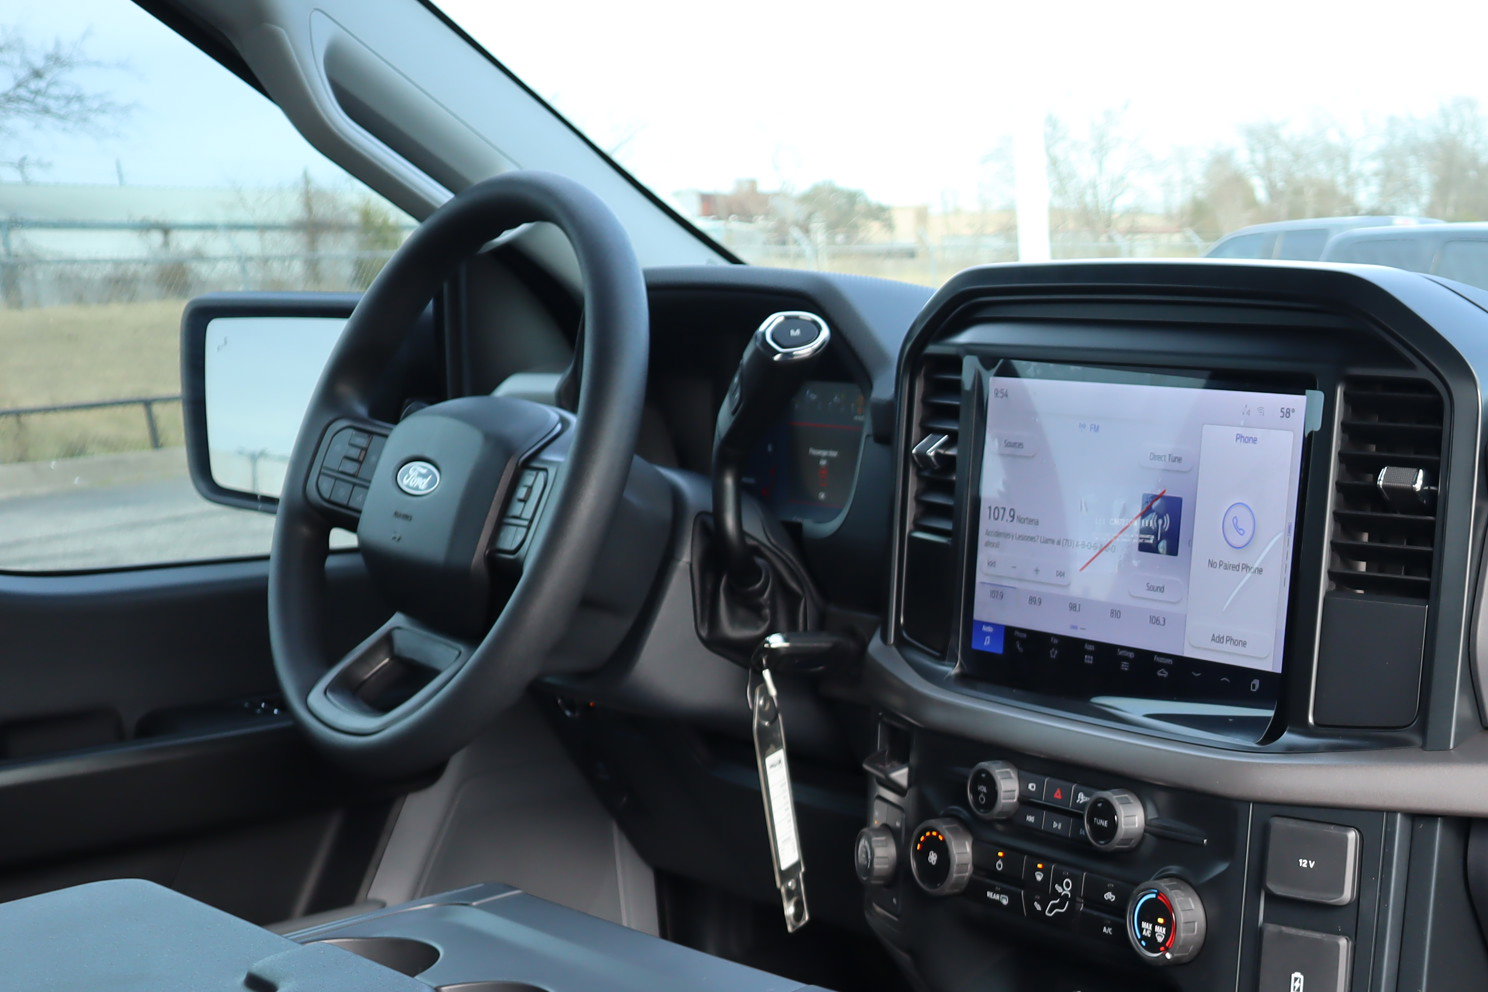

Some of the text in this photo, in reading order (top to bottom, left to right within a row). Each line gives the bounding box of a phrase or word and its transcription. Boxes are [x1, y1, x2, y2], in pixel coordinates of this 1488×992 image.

[1235, 433, 1258, 444] Phone
[1168, 453, 1183, 464] Tune
[402, 464, 433, 490] Ford
[987, 505, 1016, 523] 107.9
[1207, 558, 1217, 570] No
[1218, 560, 1240, 573] Paired
[1146, 583, 1165, 594] Sound
[1028, 595, 1042, 606] 89.9
[1109, 608, 1122, 619] 810
[1148, 615, 1167, 627] 106.3
[1210, 633, 1248, 649] Add Phone
[1093, 817, 1108, 828] TUNE
[1102, 926, 1113, 935] A/C
[1141, 921, 1153, 930] MAX
[1154, 925, 1167, 935] MAX
